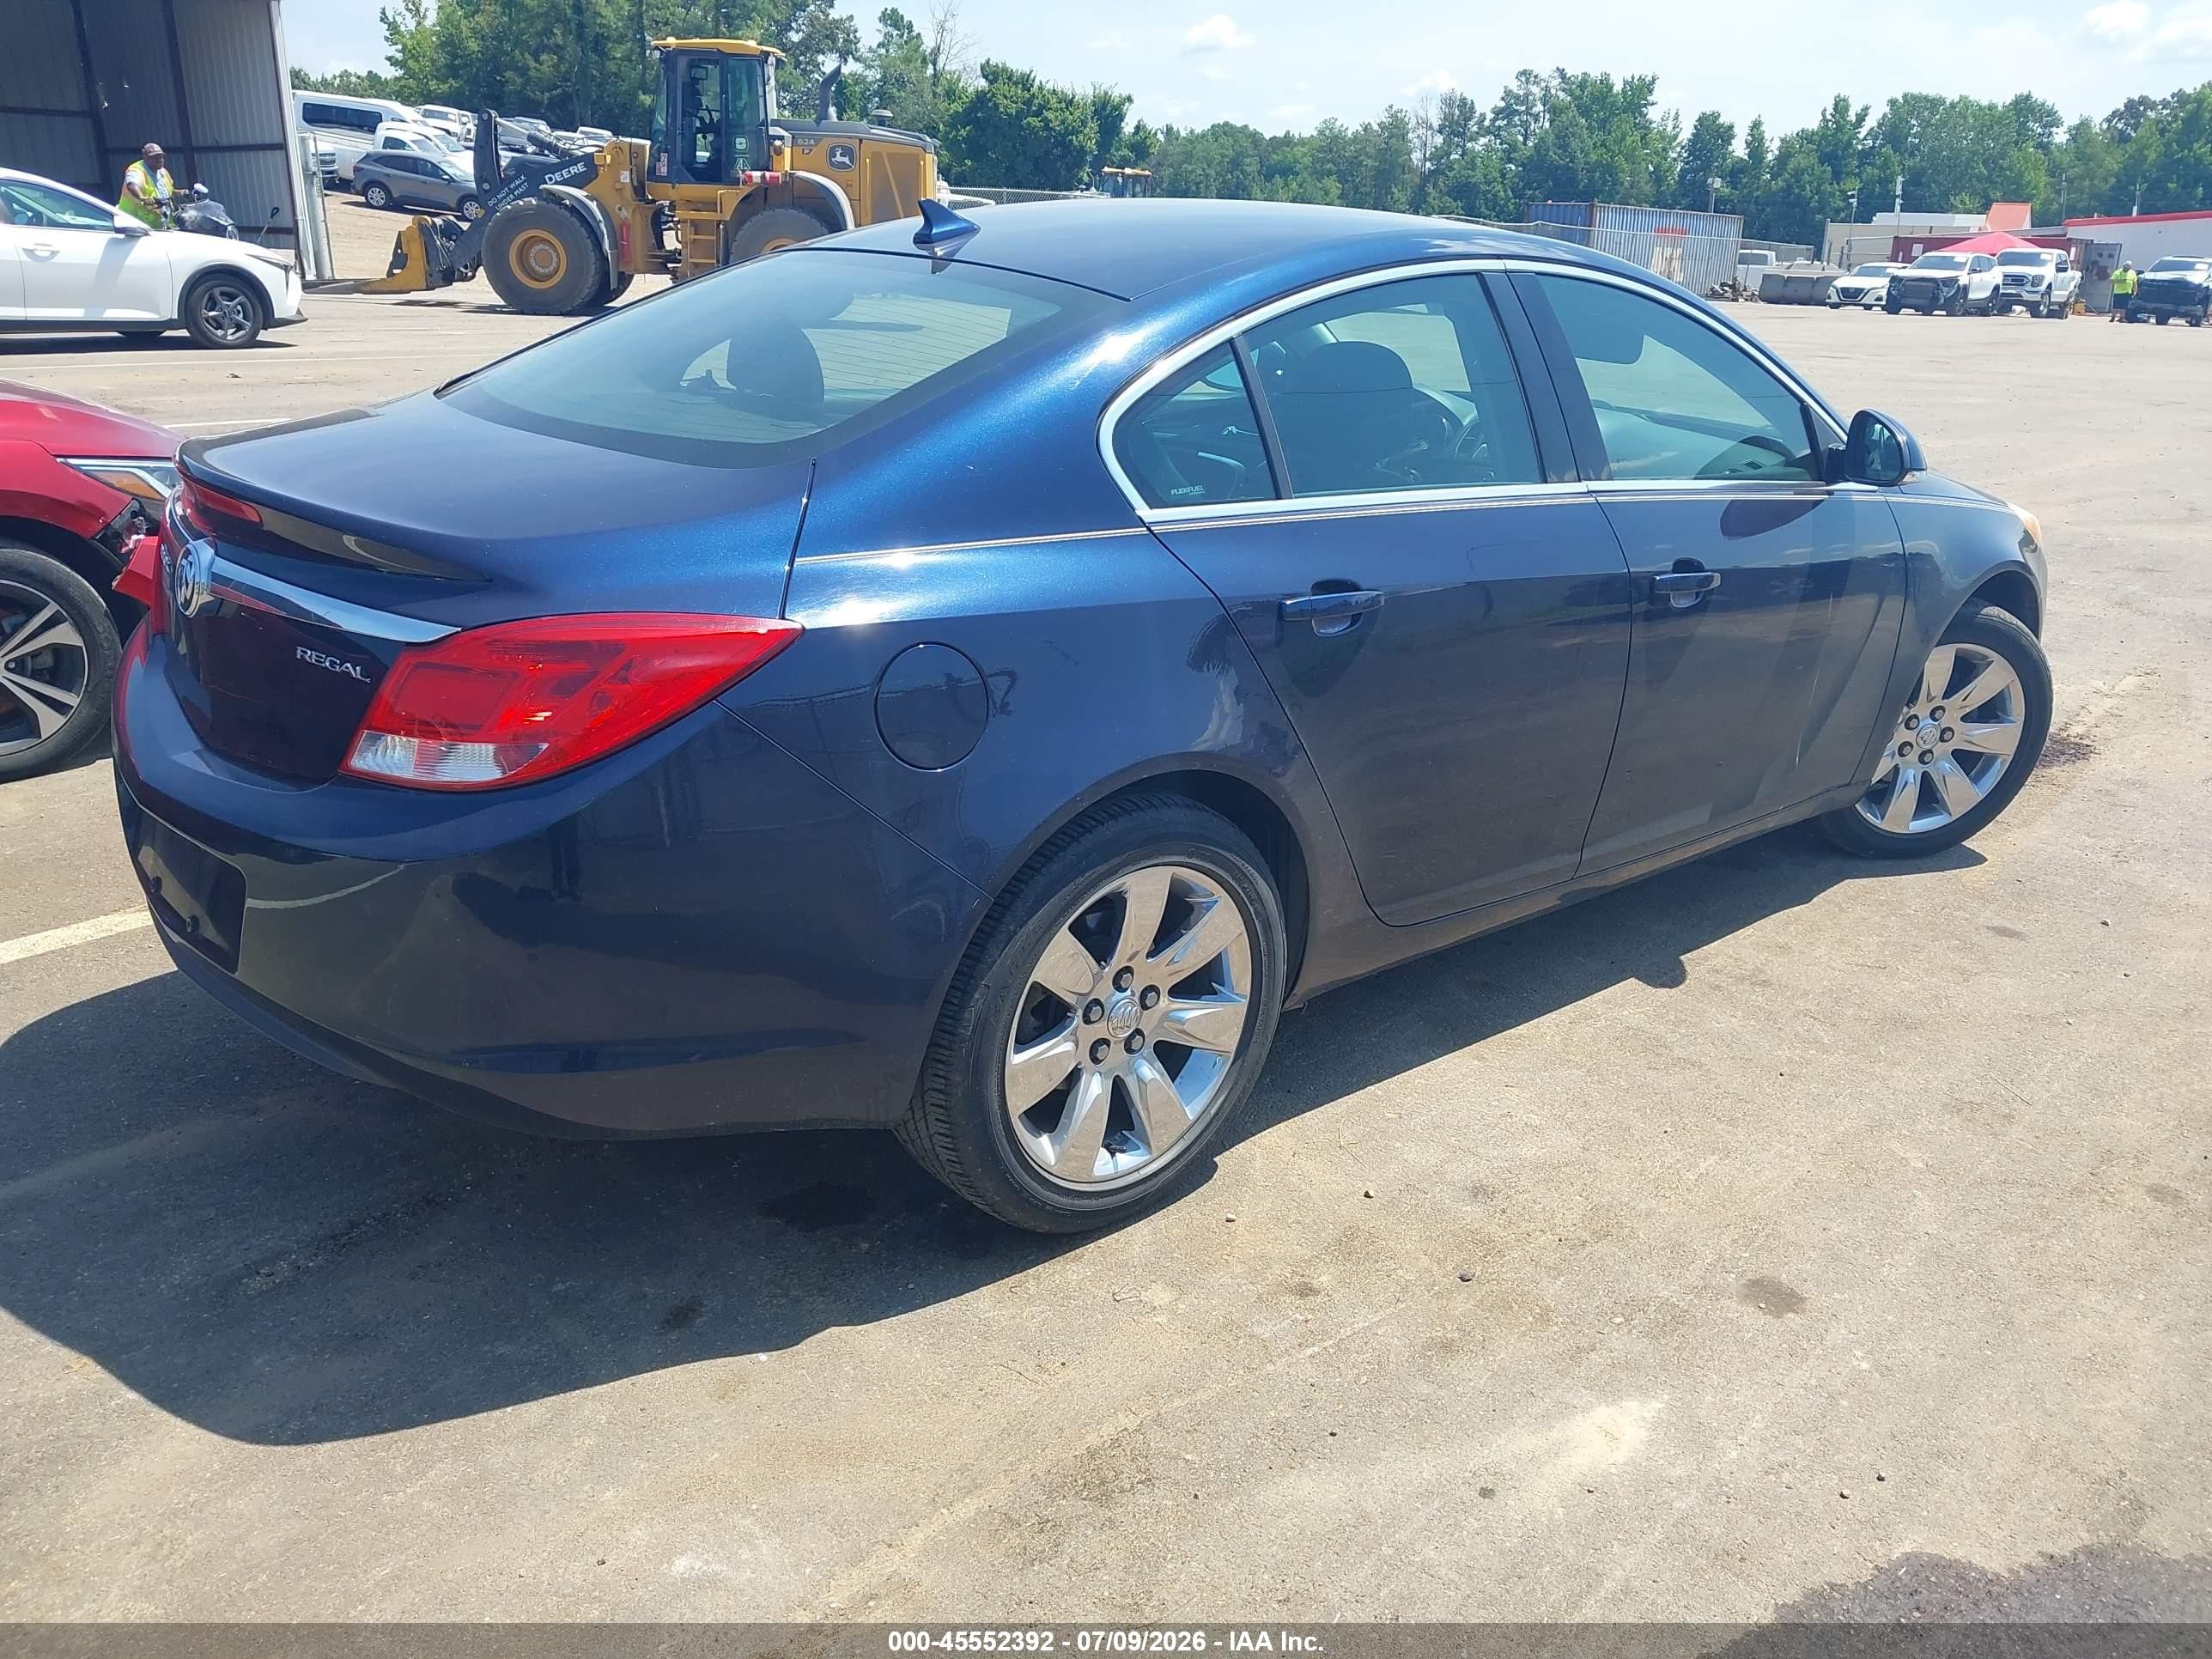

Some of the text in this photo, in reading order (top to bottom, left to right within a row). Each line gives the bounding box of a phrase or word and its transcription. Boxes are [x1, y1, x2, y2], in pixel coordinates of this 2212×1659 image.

[544, 161, 587, 185] DEERE
[488, 173, 527, 207] DO NOT WALK
[495, 181, 529, 211] UNDER MAST
[295, 646, 372, 684] REGAL
